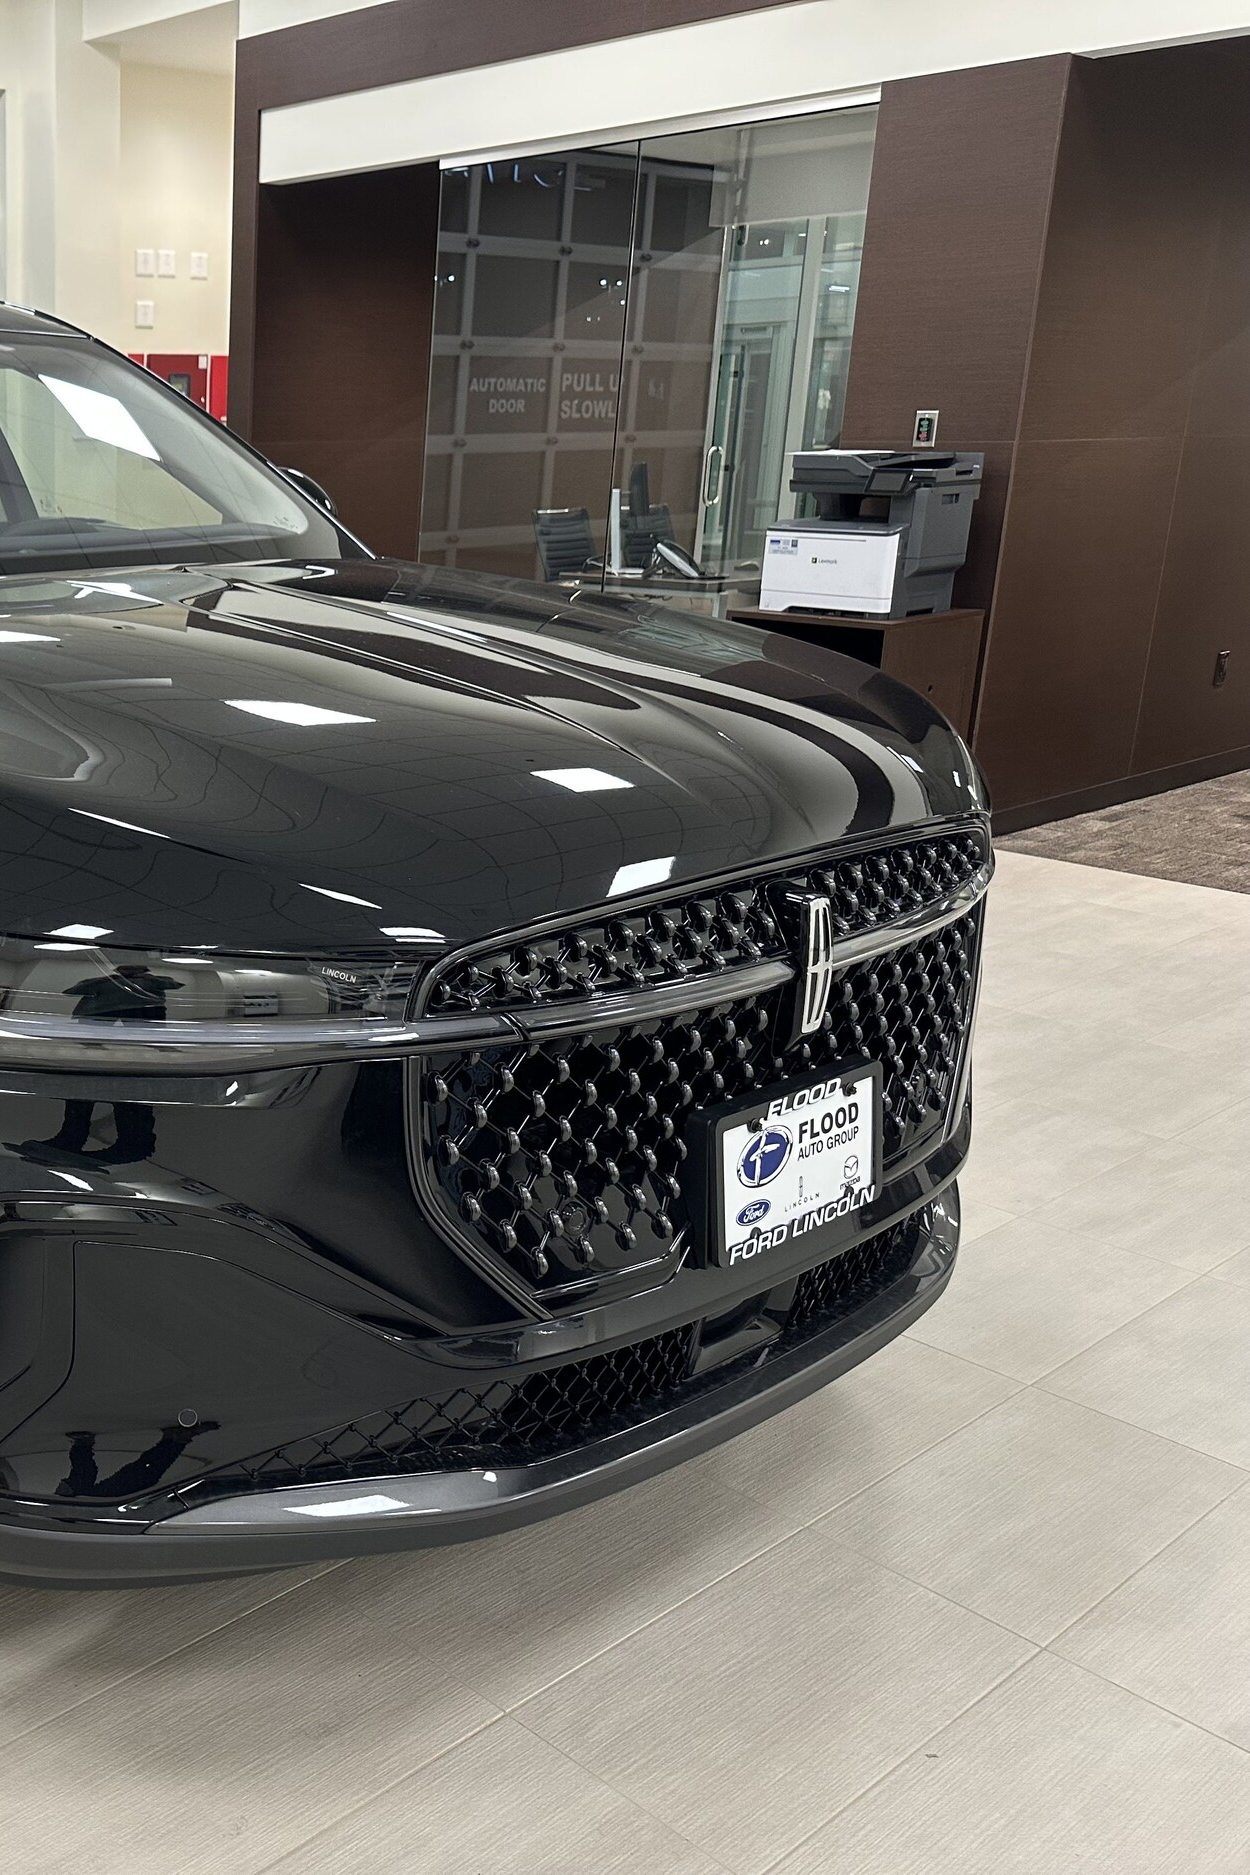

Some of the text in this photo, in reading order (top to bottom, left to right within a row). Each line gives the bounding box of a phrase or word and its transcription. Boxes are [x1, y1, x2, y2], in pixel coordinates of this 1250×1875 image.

[469, 377, 547, 392] AUTOMATIC
[561, 373, 606, 392] PULL
[488, 399, 525, 413] DOOR
[321, 966, 357, 983] LINCOLN
[767, 1077, 842, 1121] FLOOD
[798, 1102, 859, 1144] FLOOD
[797, 1126, 859, 1161] AUTO GROUP
[742, 1202, 766, 1222] Ford
[784, 1192, 820, 1213] LINCOLN
[729, 1184, 876, 1266] FORD LINCOLN
